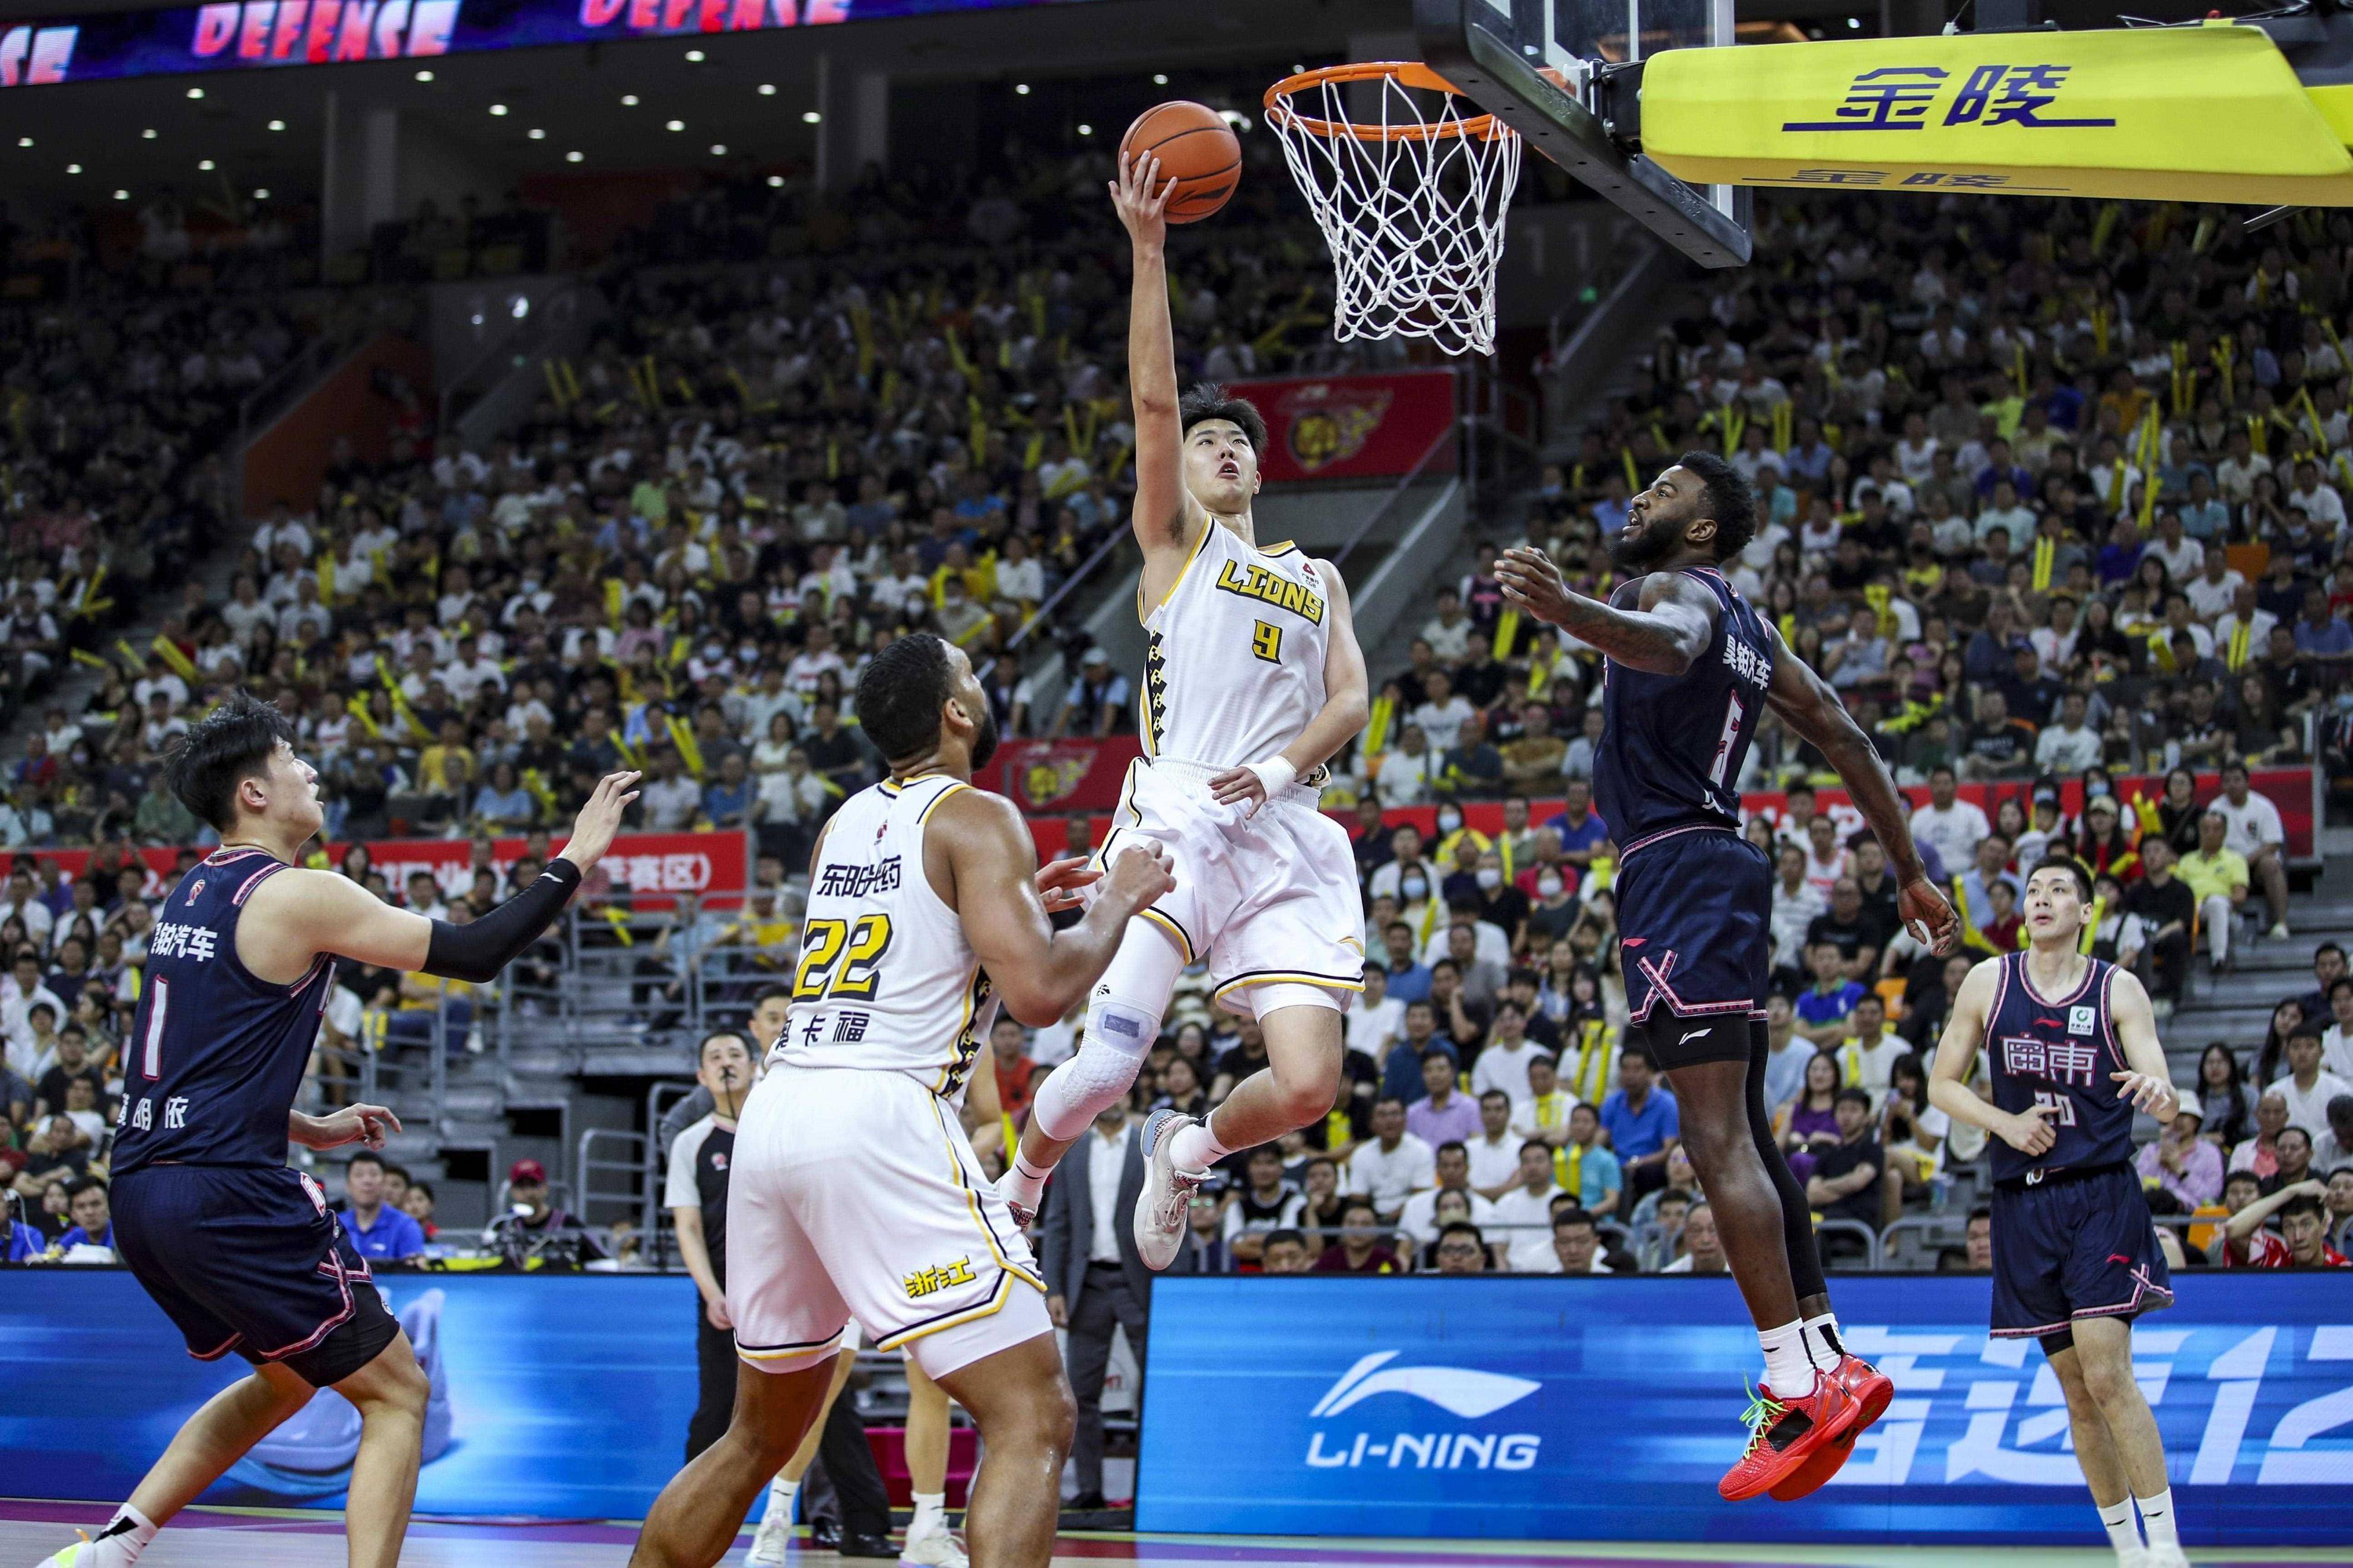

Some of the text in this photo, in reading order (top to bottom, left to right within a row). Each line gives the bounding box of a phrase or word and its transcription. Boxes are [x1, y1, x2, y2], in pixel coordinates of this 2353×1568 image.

[1781, 64, 2117, 132] 金陵
[1216, 559, 1324, 627] LIONS
[1252, 619, 1283, 665] 9
[1707, 688, 1745, 790] 5
[792, 913, 893, 1003] 22
[142, 974, 169, 1081] 1
[903, 1255, 976, 1299] 浙江
[1306, 1431, 1542, 1471] LI-NING
